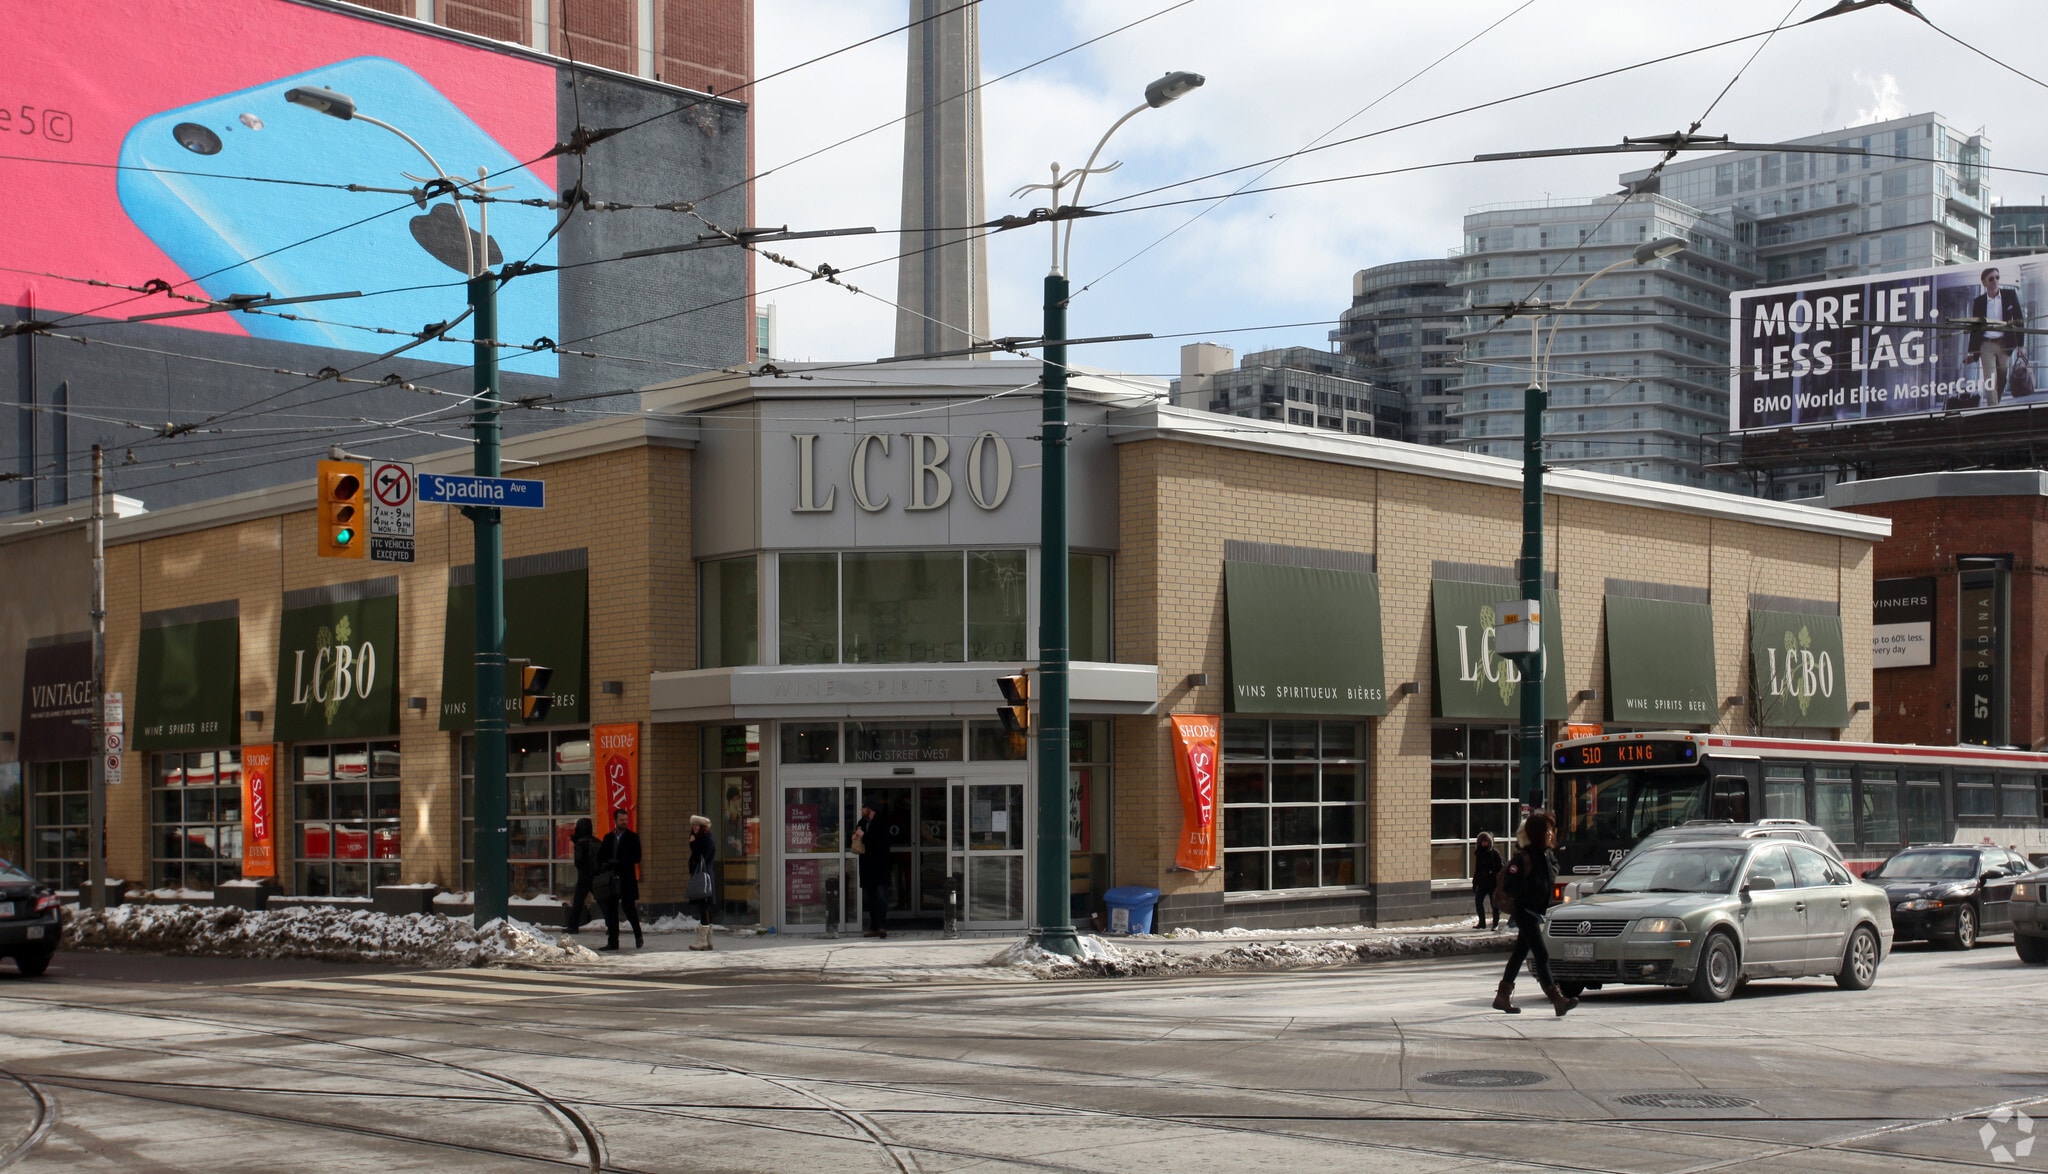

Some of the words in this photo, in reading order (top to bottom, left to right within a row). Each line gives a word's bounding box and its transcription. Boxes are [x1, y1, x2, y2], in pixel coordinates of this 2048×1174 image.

[1753, 293, 1860, 338] MORE
[1872, 285, 1939, 335] JET.
[1754, 340, 1833, 381] LESS
[1851, 330, 1938, 372] LAG.
[1753, 394, 1791, 413] BMO
[1794, 387, 1845, 409] World
[1850, 386, 1888, 404] Elite
[1893, 372, 1996, 400] MasterCard
[791, 429, 1013, 513] LCBO
[434, 477, 504, 501] Spadina
[510, 482, 527, 494] Ave
[371, 539, 383, 548] TTC
[384, 540, 415, 551] VEHICLES
[376, 549, 410, 561] EXCEPTED
[1881, 636, 1890, 644] to
[1891, 634, 1906, 643] 60%
[1978, 599, 1989, 681] SPADINA
[909, 641, 954, 659] THE
[1892, 645, 1907, 655] day
[291, 641, 376, 705] LCBO
[1767, 647, 1834, 698] LCBO
[773, 680, 835, 697] WINE
[862, 679, 948, 696] SPIRITS
[1238, 685, 1266, 698] VINS
[1276, 686, 1338, 700] SPIRITUEUX
[1347, 685, 1382, 700] BIÈRES
[444, 703, 467, 715] VINS
[1626, 698, 1648, 709] WINE
[1654, 699, 1683, 711] SPIRITS
[1689, 701, 1706, 711] BEER
[1975, 694, 1989, 718] 57
[144, 725, 163, 737] WINE
[169, 723, 195, 735] SPIRITS
[200, 721, 218, 733] BEER
[888, 730, 919, 747] 415
[855, 749, 882, 761] KING
[884, 749, 920, 761] STREET
[922, 748, 952, 760] WEST
[1582, 748, 1601, 764] 510
[1618, 745, 1653, 761] KING
[610, 763, 627, 812] SAV
[1194, 751, 1213, 823] SAVE
[252, 778, 265, 838] SAVE
[791, 823, 811, 831] HAVE
[249, 845, 271, 858] EVENT
